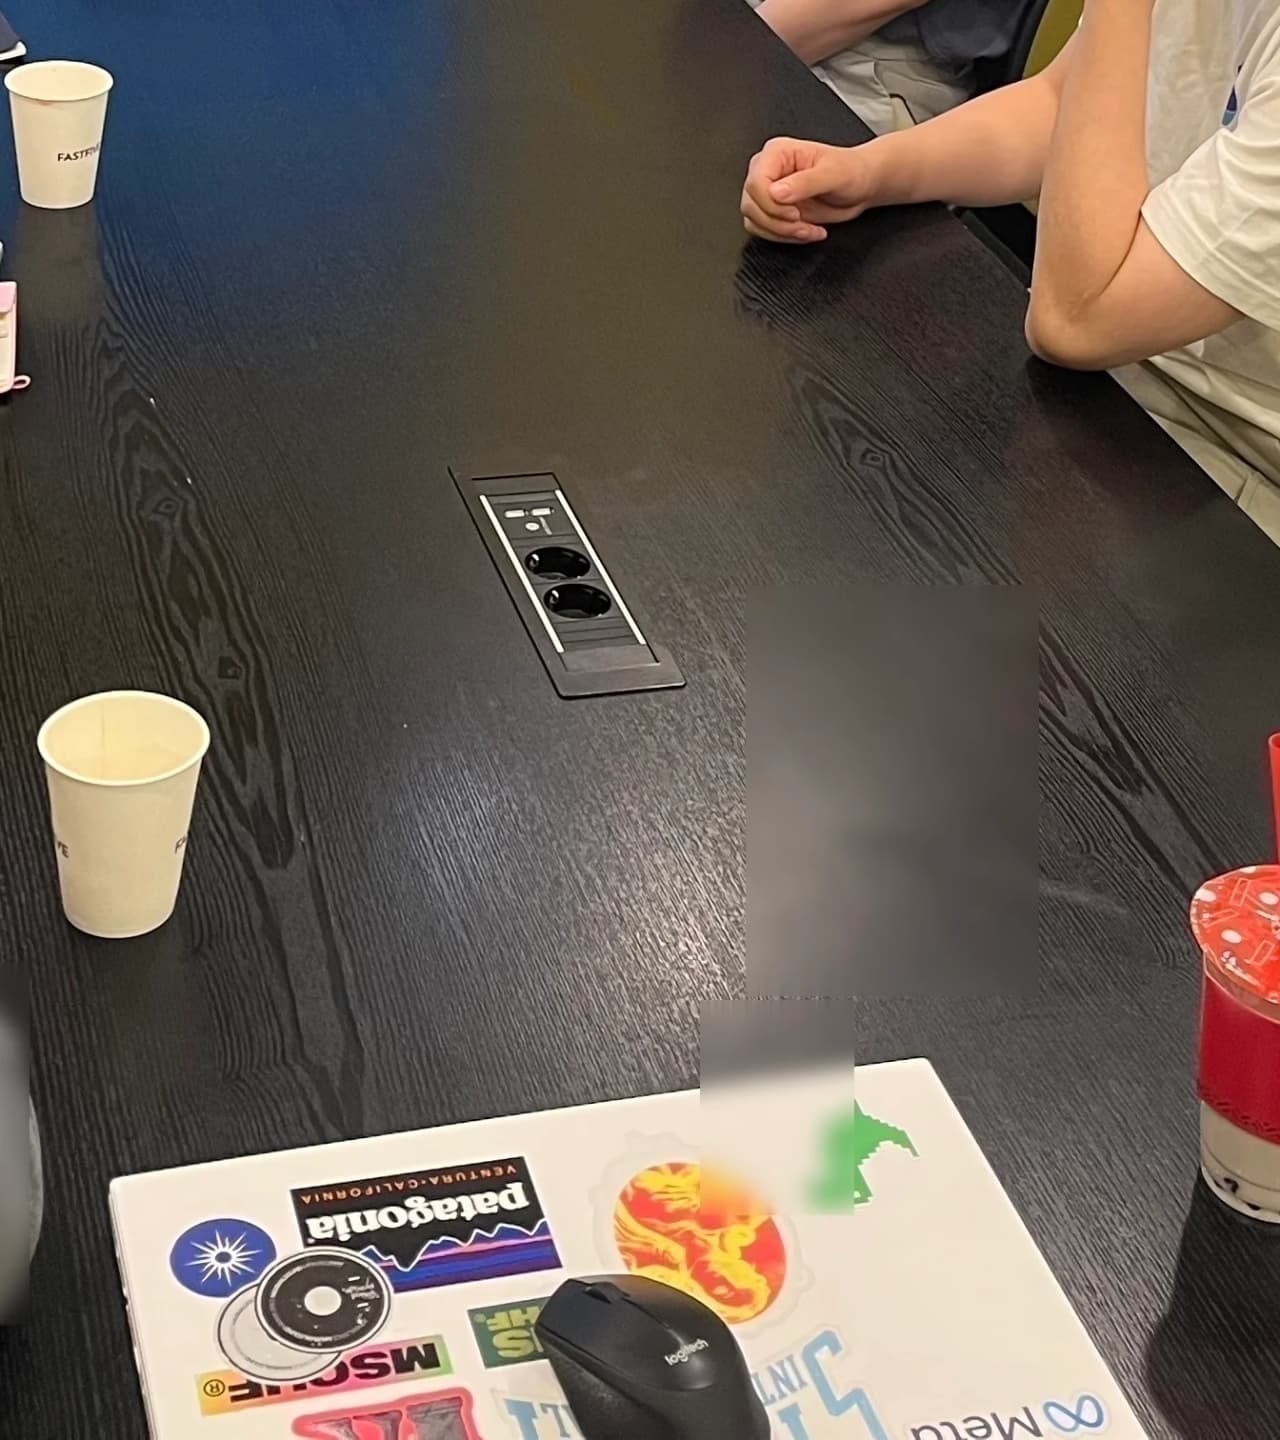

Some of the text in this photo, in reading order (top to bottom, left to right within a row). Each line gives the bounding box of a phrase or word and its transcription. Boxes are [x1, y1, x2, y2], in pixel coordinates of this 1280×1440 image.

[301, 1164, 517, 1205] VENTURA CALIFORNIA
[305, 1182, 531, 1243] patagonia
[664, 1338, 709, 1366] logitech
